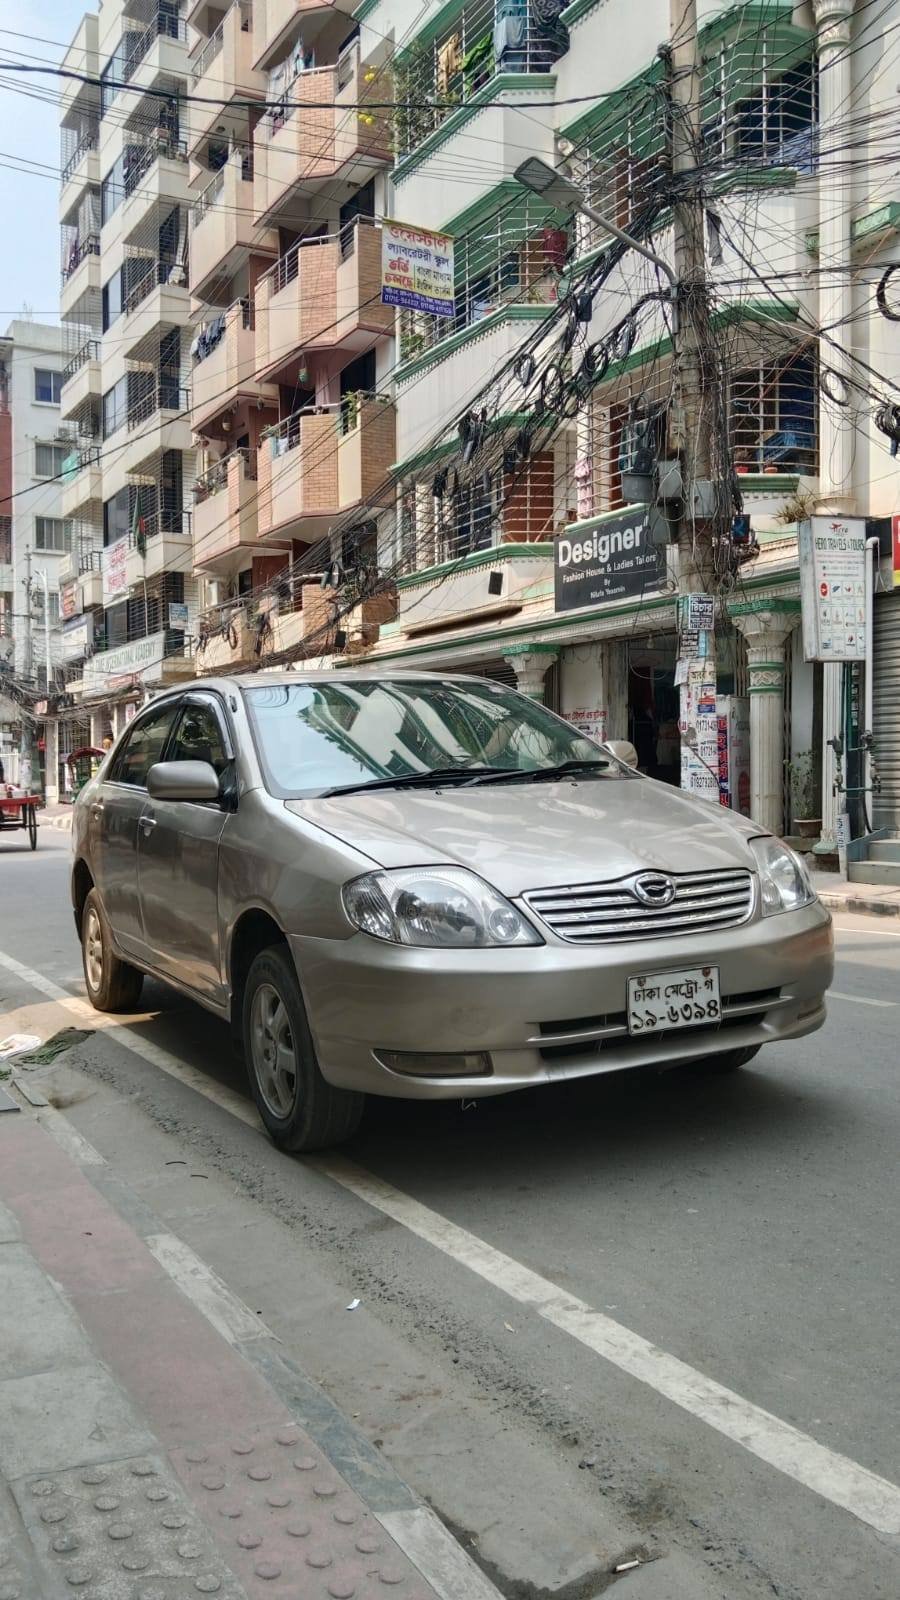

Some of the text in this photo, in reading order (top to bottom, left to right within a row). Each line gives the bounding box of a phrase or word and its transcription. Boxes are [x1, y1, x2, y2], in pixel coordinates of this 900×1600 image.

[388, 257, 410, 273] ভর্তি
[562, 554, 656, 584] Fashion House & Ladies Taiors
[634, 986, 660, 1002] ঢাকা
[632, 999, 718, 1029] ১৯-৬৩৯৪
